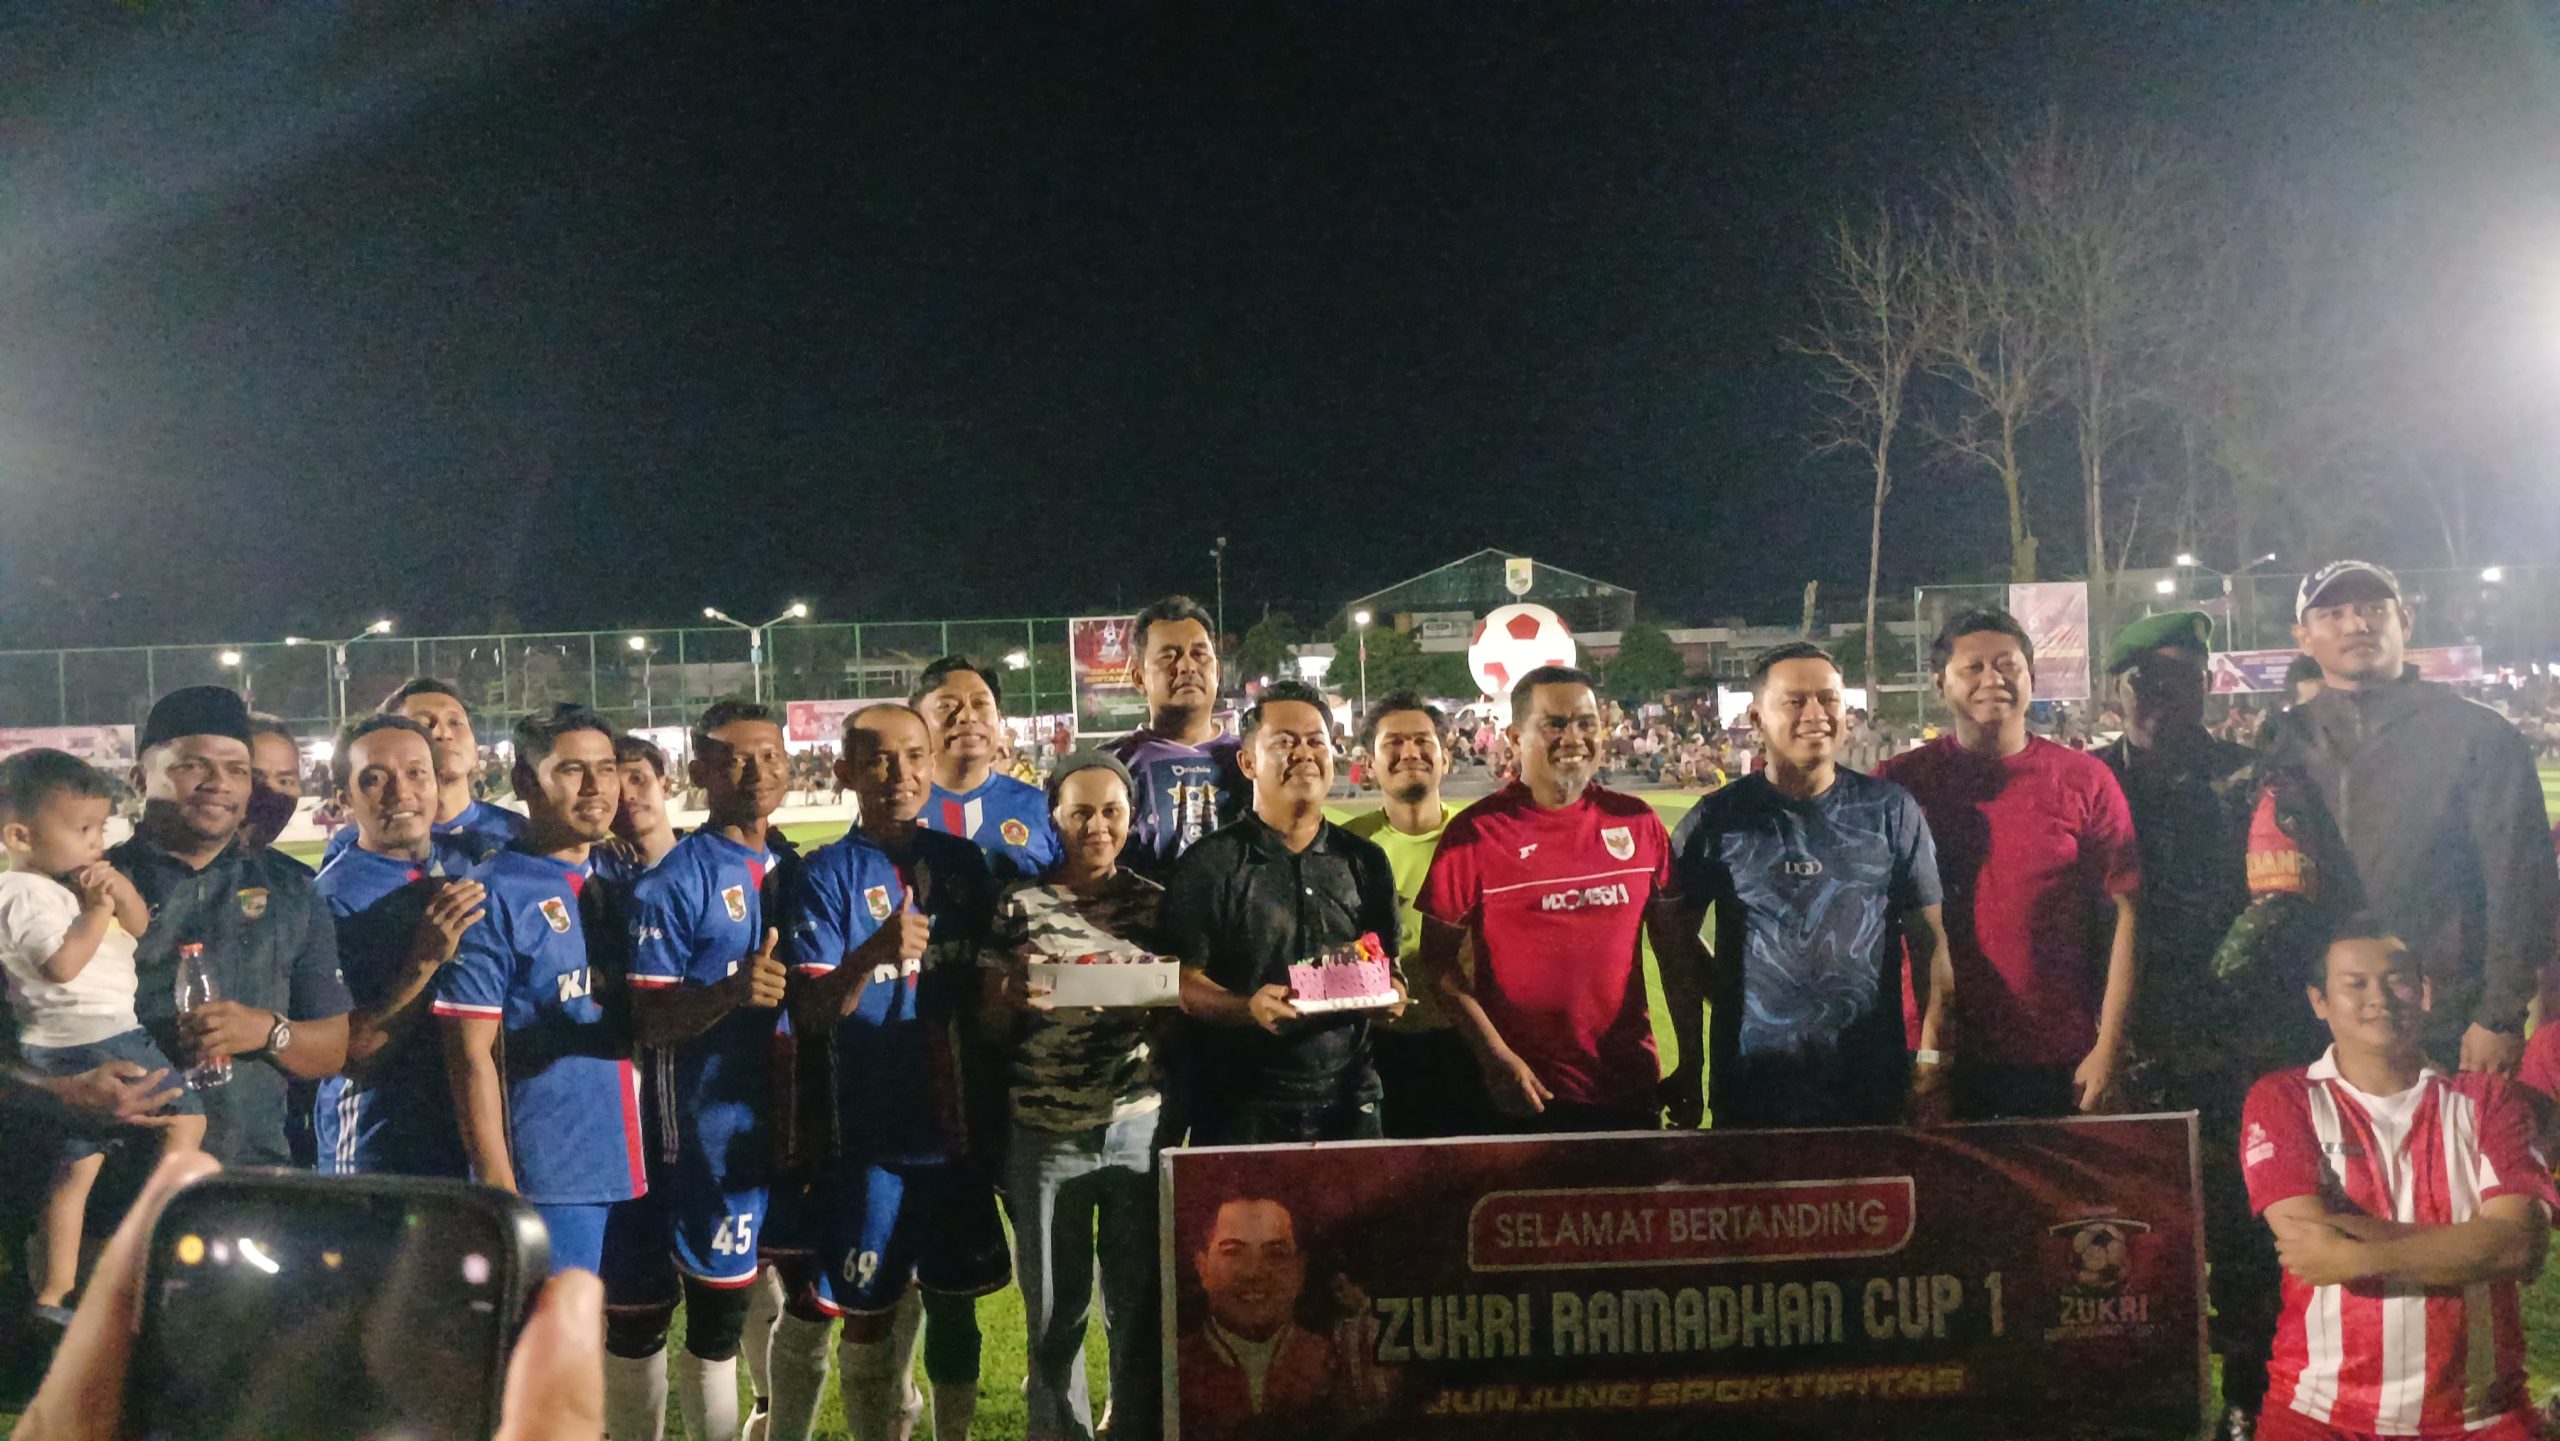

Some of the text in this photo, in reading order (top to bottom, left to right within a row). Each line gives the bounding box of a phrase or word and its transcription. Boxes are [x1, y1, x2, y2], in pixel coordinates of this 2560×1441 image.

[711, 1212, 753, 1256] 45
[1495, 1199, 1888, 1248] SELAMAT BERTANDING
[842, 1247, 879, 1288] 69
[1552, 1280, 1844, 1356] RAMADHAN
[1862, 1273, 1963, 1339] CUP
[1984, 1270, 2006, 1338] 1
[2058, 1294, 2149, 1324] ZUKRI
